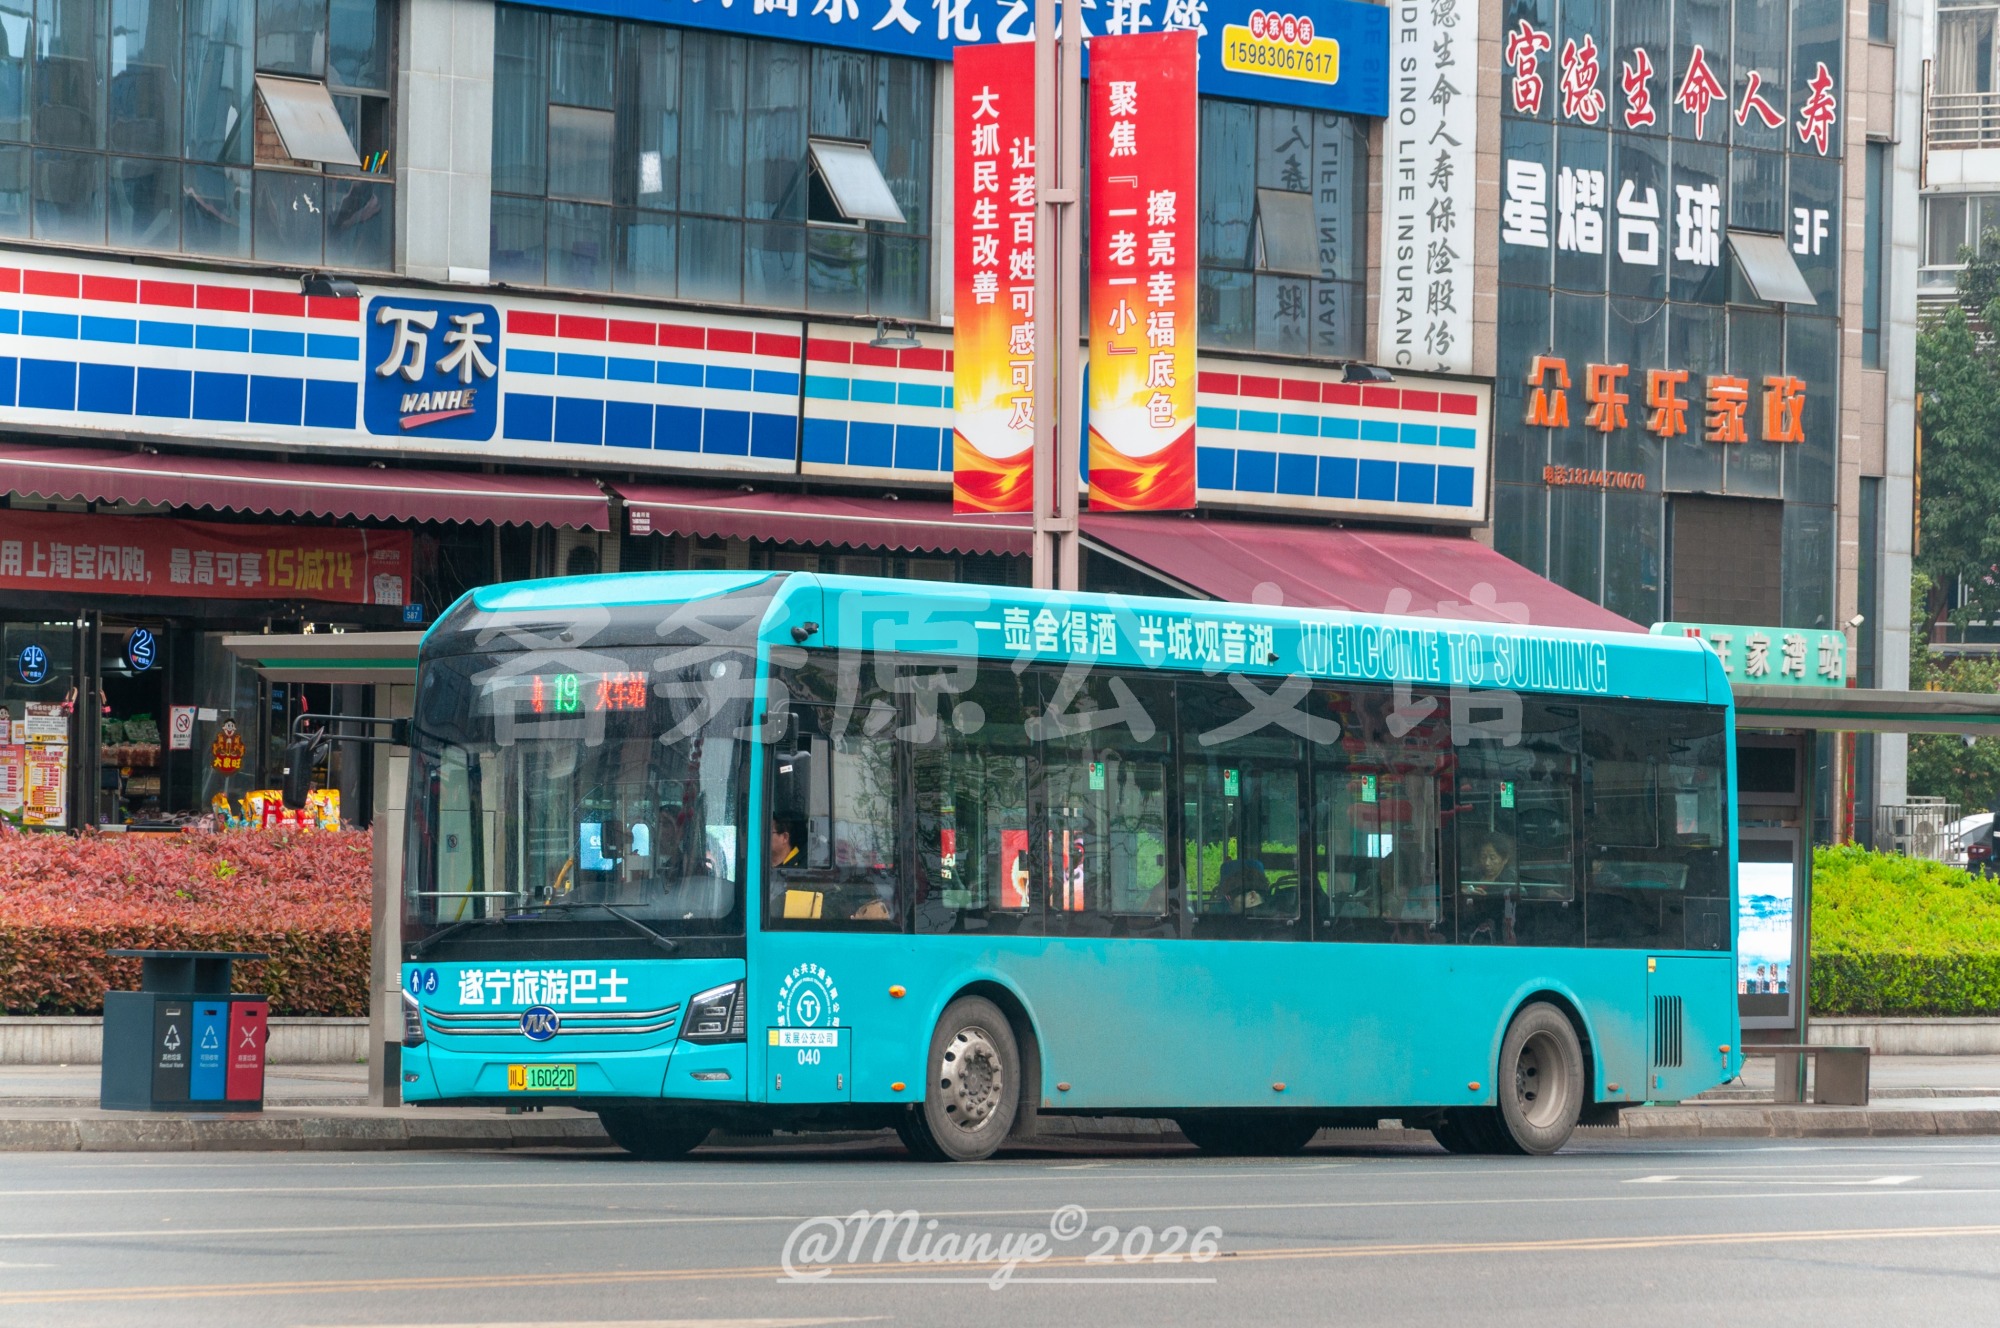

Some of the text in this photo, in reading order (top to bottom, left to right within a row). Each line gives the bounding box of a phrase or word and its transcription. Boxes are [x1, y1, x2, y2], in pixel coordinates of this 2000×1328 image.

[1230, 41, 1333, 74] 15983067617
[1253, 16, 1311, 42] 联系电话
[1400, 56, 1417, 126] SINO
[1506, 19, 1836, 156] 富德生命人寿
[971, 85, 1000, 304] 大抓民生改善
[1398, 140, 1416, 201] LIFE
[1502, 159, 1829, 267] 星熠台球 3F
[1008, 136, 1035, 430] 让老百姓可感可及
[1146, 189, 1177, 429] 擦亮幸福底色
[1395, 215, 1414, 366] INSURANC
[376, 305, 497, 384] 万禾
[400, 389, 477, 413] WANHE
[1525, 355, 1805, 444] 众乐乐家政
[406, 611, 419, 620] 587
[974, 607, 1275, 666] 一壶舍得酒 半城观音湖
[1299, 620, 1608, 693] WELCOME TO SUINING
[1710, 632, 1844, 680] 王家湾站
[554, 674, 578, 711] 19
[594, 672, 646, 711] 火车站
[458, 968, 629, 1005] 遂宁旅游巴士
[784, 1032, 834, 1045] 发展公交公司
[797, 1048, 821, 1065] 040
